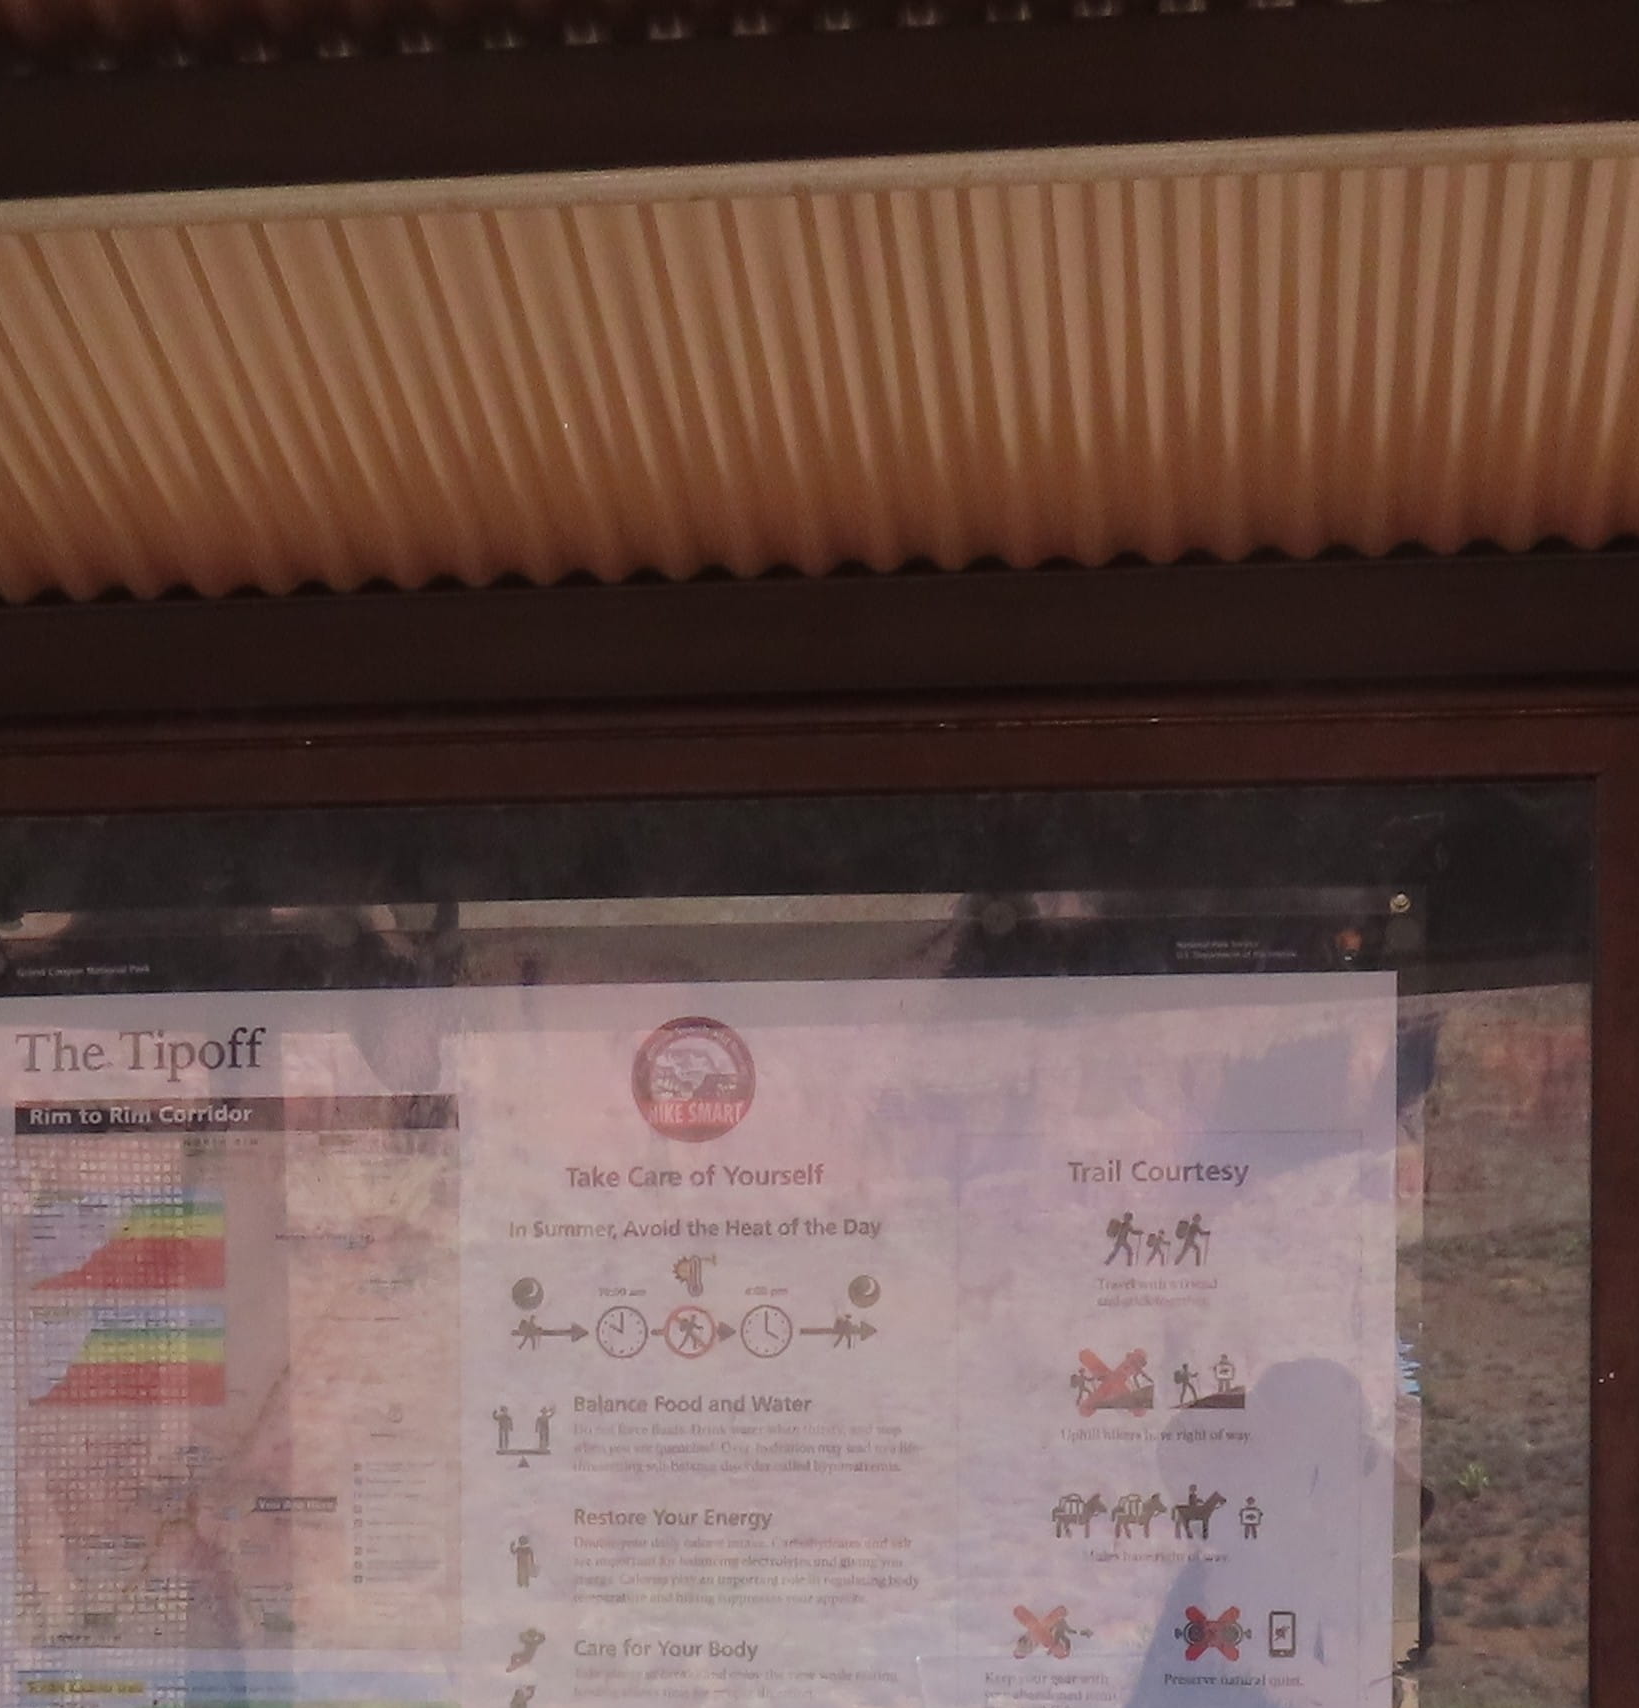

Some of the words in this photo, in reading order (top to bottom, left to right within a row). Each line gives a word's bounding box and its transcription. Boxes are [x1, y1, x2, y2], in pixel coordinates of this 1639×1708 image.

[15, 1031, 105, 1072] The
[118, 1026, 267, 1082] Tipoff
[29, 1108, 72, 1126] Rim
[78, 1109, 103, 1125] to
[110, 1106, 152, 1124] Rim
[158, 1104, 254, 1124] Corridor
[687, 1101, 743, 1122] SMART
[565, 1165, 621, 1188] Take
[628, 1165, 683, 1188] Care
[689, 1163, 716, 1187] of
[722, 1162, 825, 1186] Yourself
[1067, 1160, 1122, 1183] Trail
[1131, 1161, 1250, 1187] Courtesy
[508, 1220, 527, 1239] In
[533, 1220, 617, 1241] Summer,
[623, 1219, 681, 1238] Avoid
[687, 1218, 720, 1237] the
[725, 1218, 773, 1237] Heat
[777, 1217, 800, 1236] of
[804, 1217, 838, 1236] the
[843, 1218, 882, 1238] Day
[573, 1394, 648, 1413] Balance
[654, 1395, 703, 1413] Food
[708, 1395, 746, 1413] and
[751, 1395, 813, 1413] Water
[1061, 1428, 1100, 1444] Uphill
[1177, 1429, 1207, 1445] right
[1210, 1428, 1225, 1442] of
[573, 1508, 647, 1526] Restore
[653, 1508, 699, 1526] Your
[703, 1508, 773, 1531] Energy
[573, 1639, 617, 1657] Care
[623, 1638, 652, 1657] for
[657, 1640, 703, 1657] Your
[708, 1640, 758, 1661] Body
[1164, 1673, 1218, 1688] Preserve
[1220, 1673, 1266, 1687] natural
